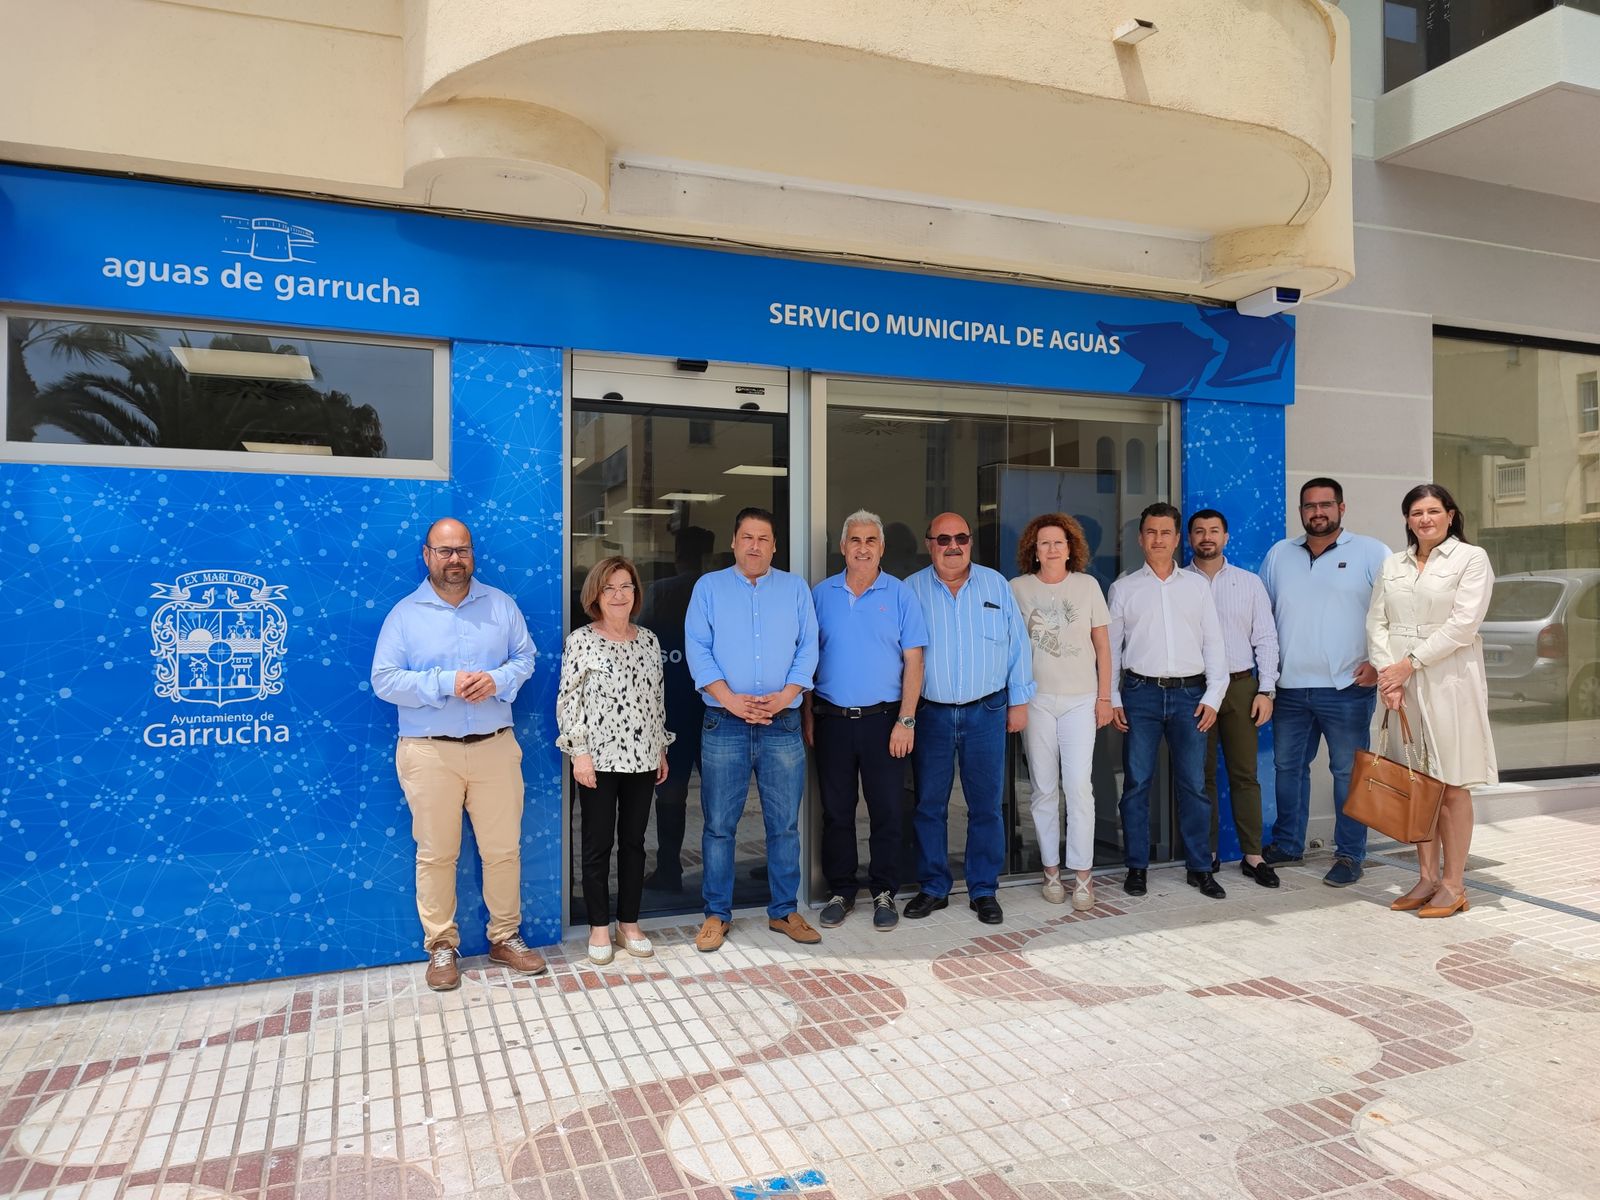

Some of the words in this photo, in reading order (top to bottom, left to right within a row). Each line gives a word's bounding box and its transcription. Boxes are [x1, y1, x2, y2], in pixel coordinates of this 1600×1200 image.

[102, 257, 209, 287] aguas
[220, 262, 263, 291] de
[275, 275, 420, 306] garrucha
[769, 302, 880, 333] SERVICIO
[886, 314, 1011, 345] MUNICIPAL
[1016, 326, 1044, 348] DE
[1049, 330, 1121, 355] AGUAS
[184, 575, 198, 585] EX
[203, 573, 228, 582] MARI
[233, 574, 260, 587] ORTA
[170, 712, 254, 726] Ayuntamiento
[260, 711, 274, 721] de
[143, 719, 290, 748] Garrucha
